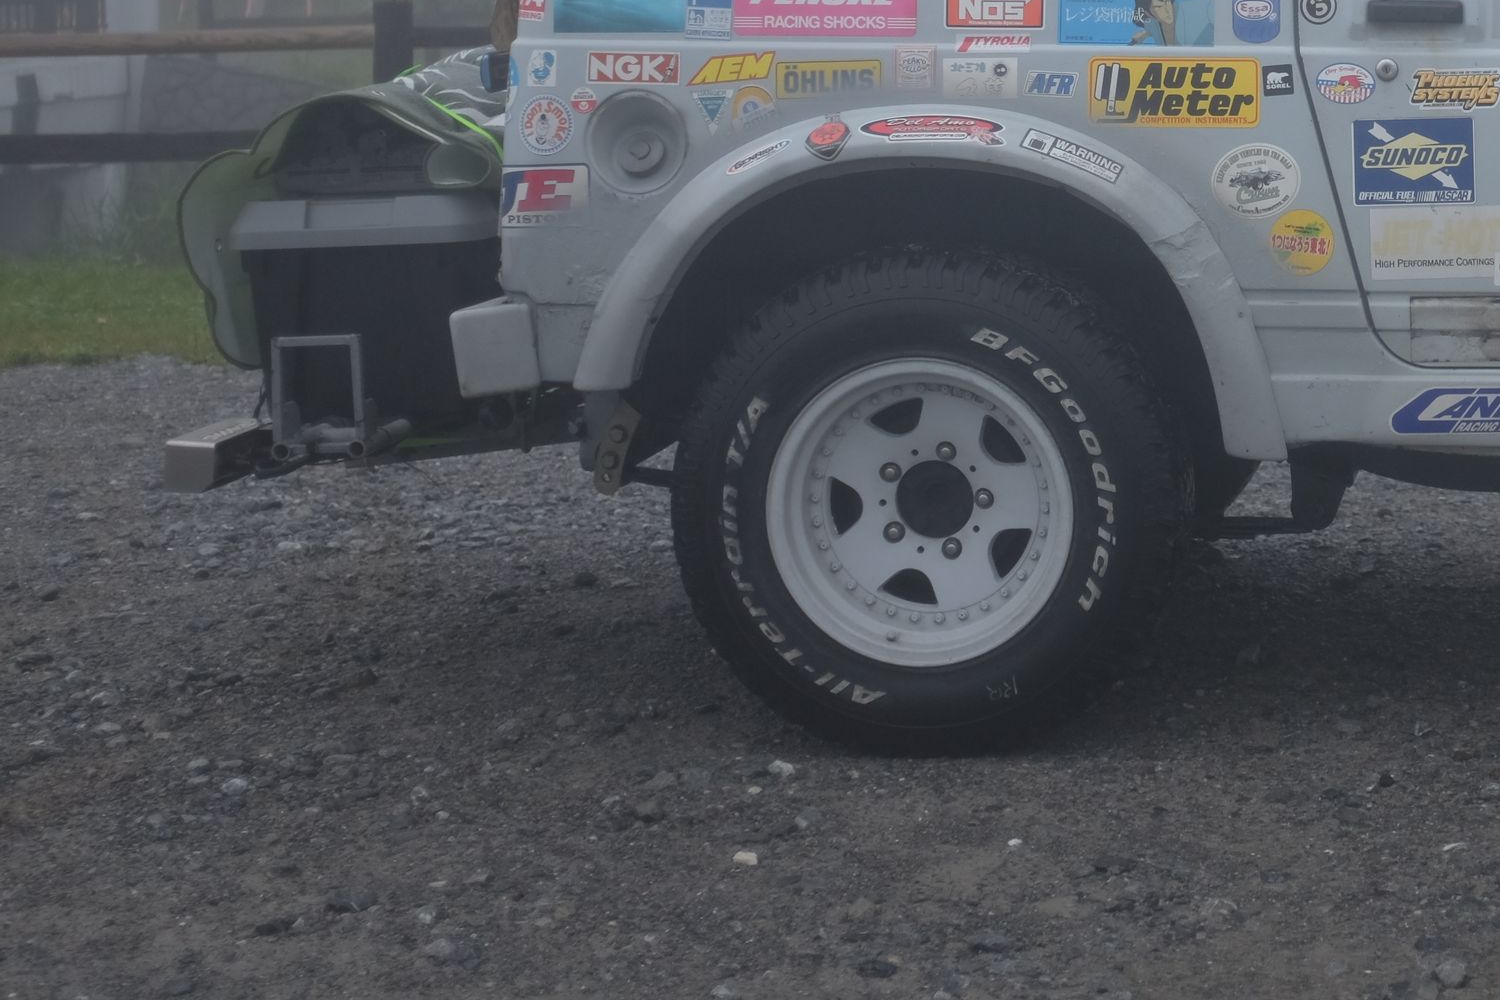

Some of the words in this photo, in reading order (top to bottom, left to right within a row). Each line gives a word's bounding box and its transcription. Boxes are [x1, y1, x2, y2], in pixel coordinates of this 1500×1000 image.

[764, 16, 821, 29] RACING
[823, 15, 886, 29] SHOCKS
[974, 36, 1030, 47] TYROLIA
[590, 55, 665, 82] NGK
[688, 51, 775, 86] AEM
[1138, 63, 1236, 89] Auto
[783, 64, 874, 94] ÖHLINS
[1027, 73, 1074, 95] AFR
[1266, 82, 1291, 91] SOREL
[1415, 70, 1500, 88] PHOENIX
[1134, 89, 1254, 117] Meter
[1412, 86, 1500, 103] SYSTEMS
[1140, 116, 1191, 125] COMPETITION
[1195, 116, 1248, 125] INSTRUMENTS
[1055, 139, 1122, 174] WARNING
[1366, 147, 1464, 167] SUNOCO
[1359, 191, 1395, 201] OFFICIAL
[1396, 191, 1416, 201] FUEL
[1432, 191, 1472, 201] NASCAR
[1375, 259, 1395, 268] HIGH
[1397, 258, 1454, 268] PERFORMANCE
[1456, 257, 1495, 267] COATINGS
[1455, 420, 1497, 433] RACING
[971, 326, 1118, 613] BFGoodrich
